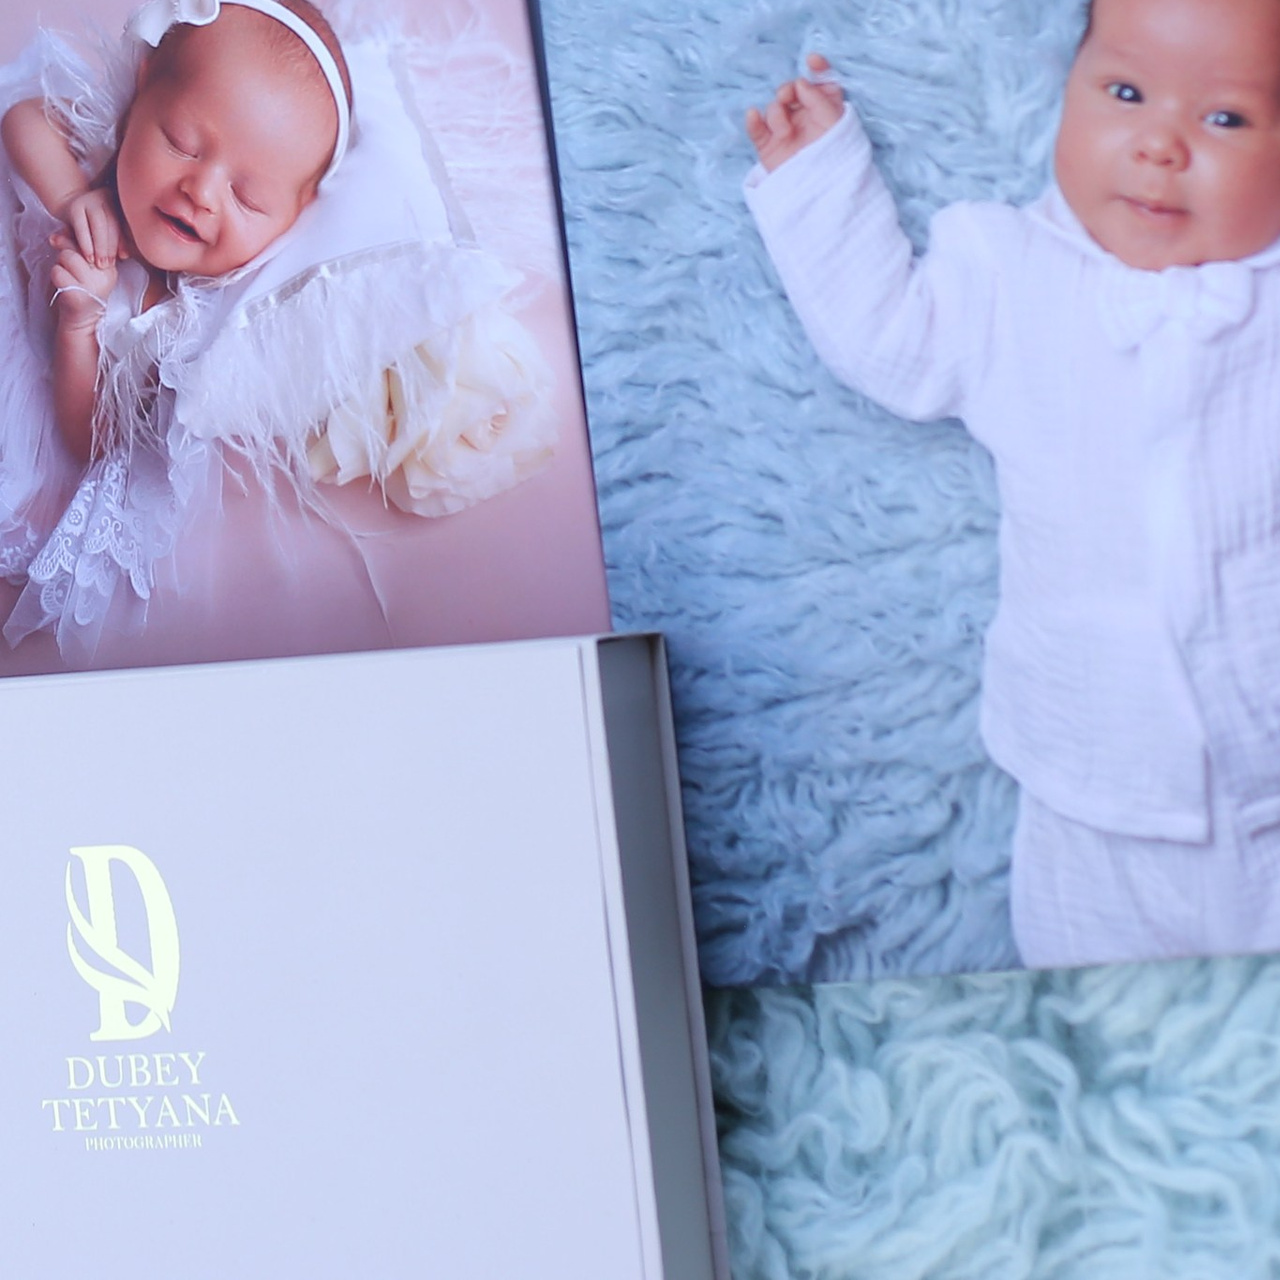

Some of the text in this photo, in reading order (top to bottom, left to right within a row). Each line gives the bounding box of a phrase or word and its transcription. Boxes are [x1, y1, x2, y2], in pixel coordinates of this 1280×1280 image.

[65, 1052, 206, 1090] DUBEY
[41, 1093, 241, 1132] TETYANA
[85, 1133, 203, 1151] PHOTOGRAPHER
